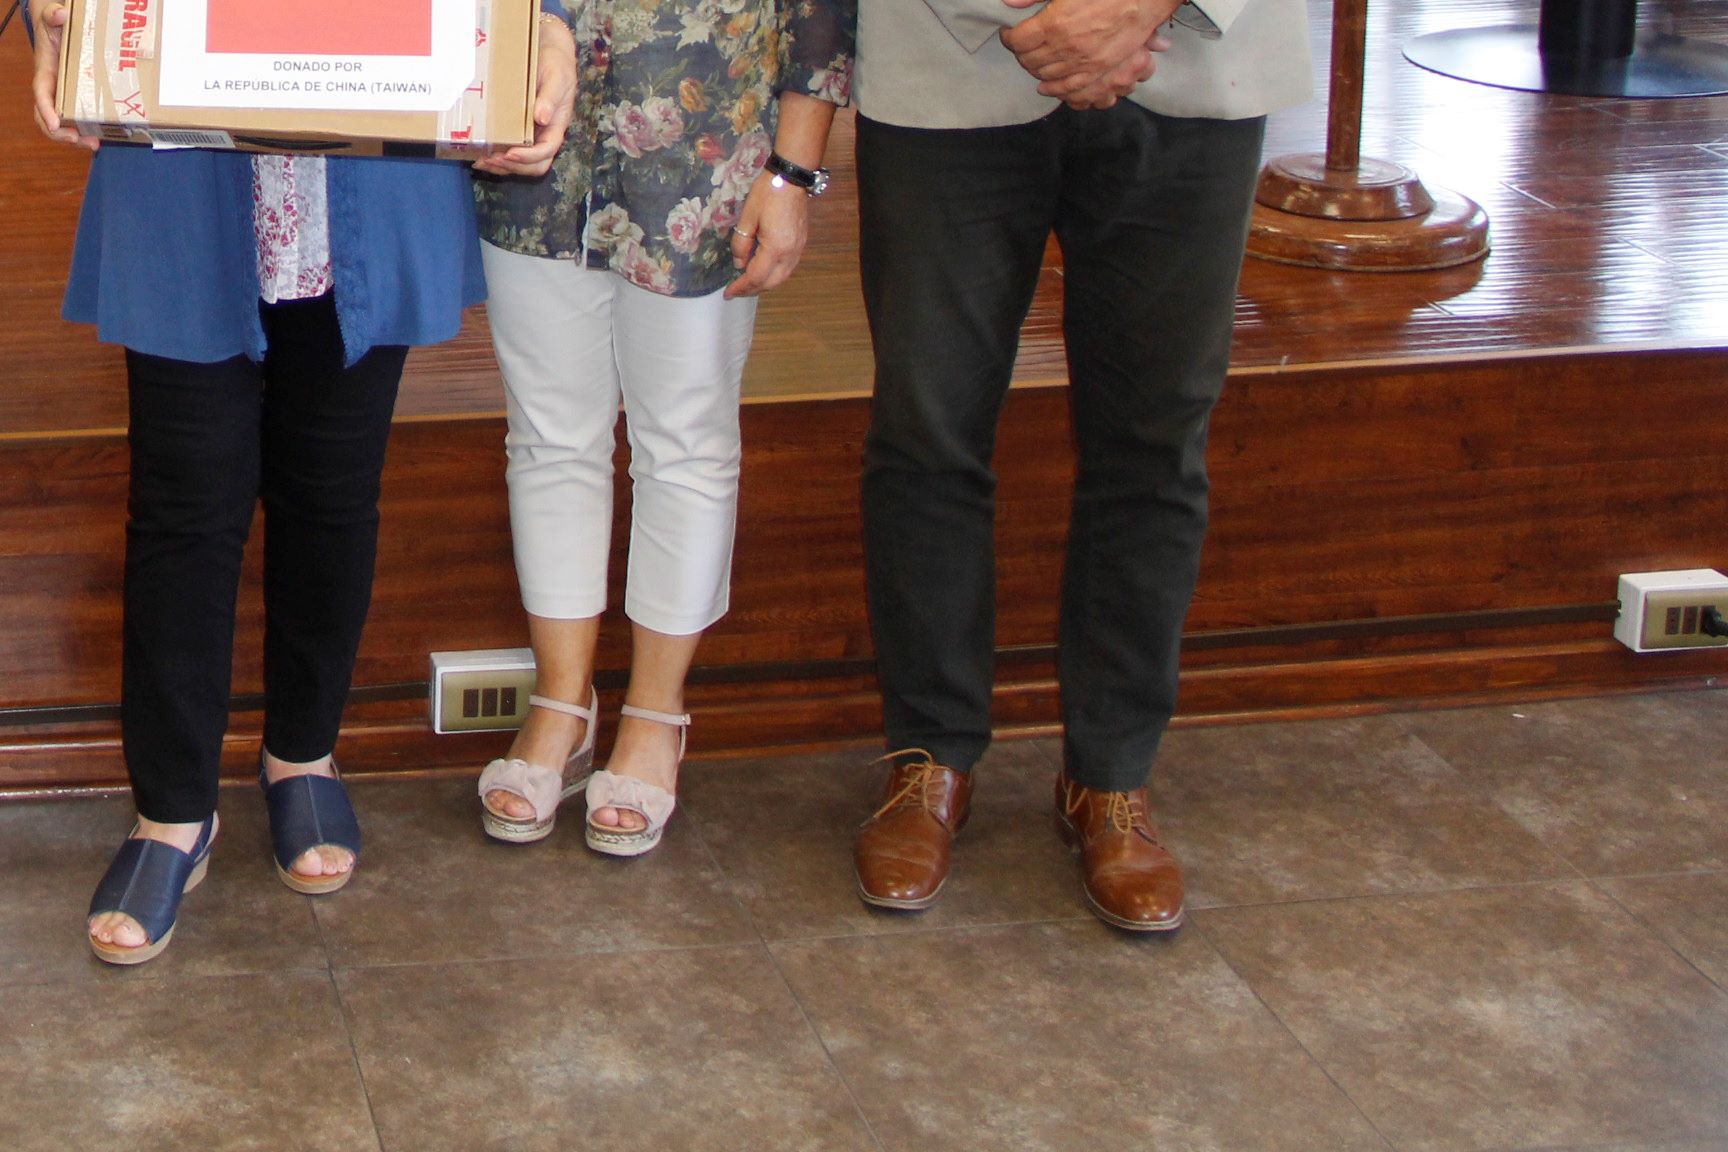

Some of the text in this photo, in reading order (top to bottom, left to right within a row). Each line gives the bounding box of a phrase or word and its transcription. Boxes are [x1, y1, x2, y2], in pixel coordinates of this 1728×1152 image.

[273, 61, 362, 72] DONADO POR
[204, 80, 221, 90] LA
[304, 81, 321, 92] DE
[325, 81, 367, 92] CHINA
